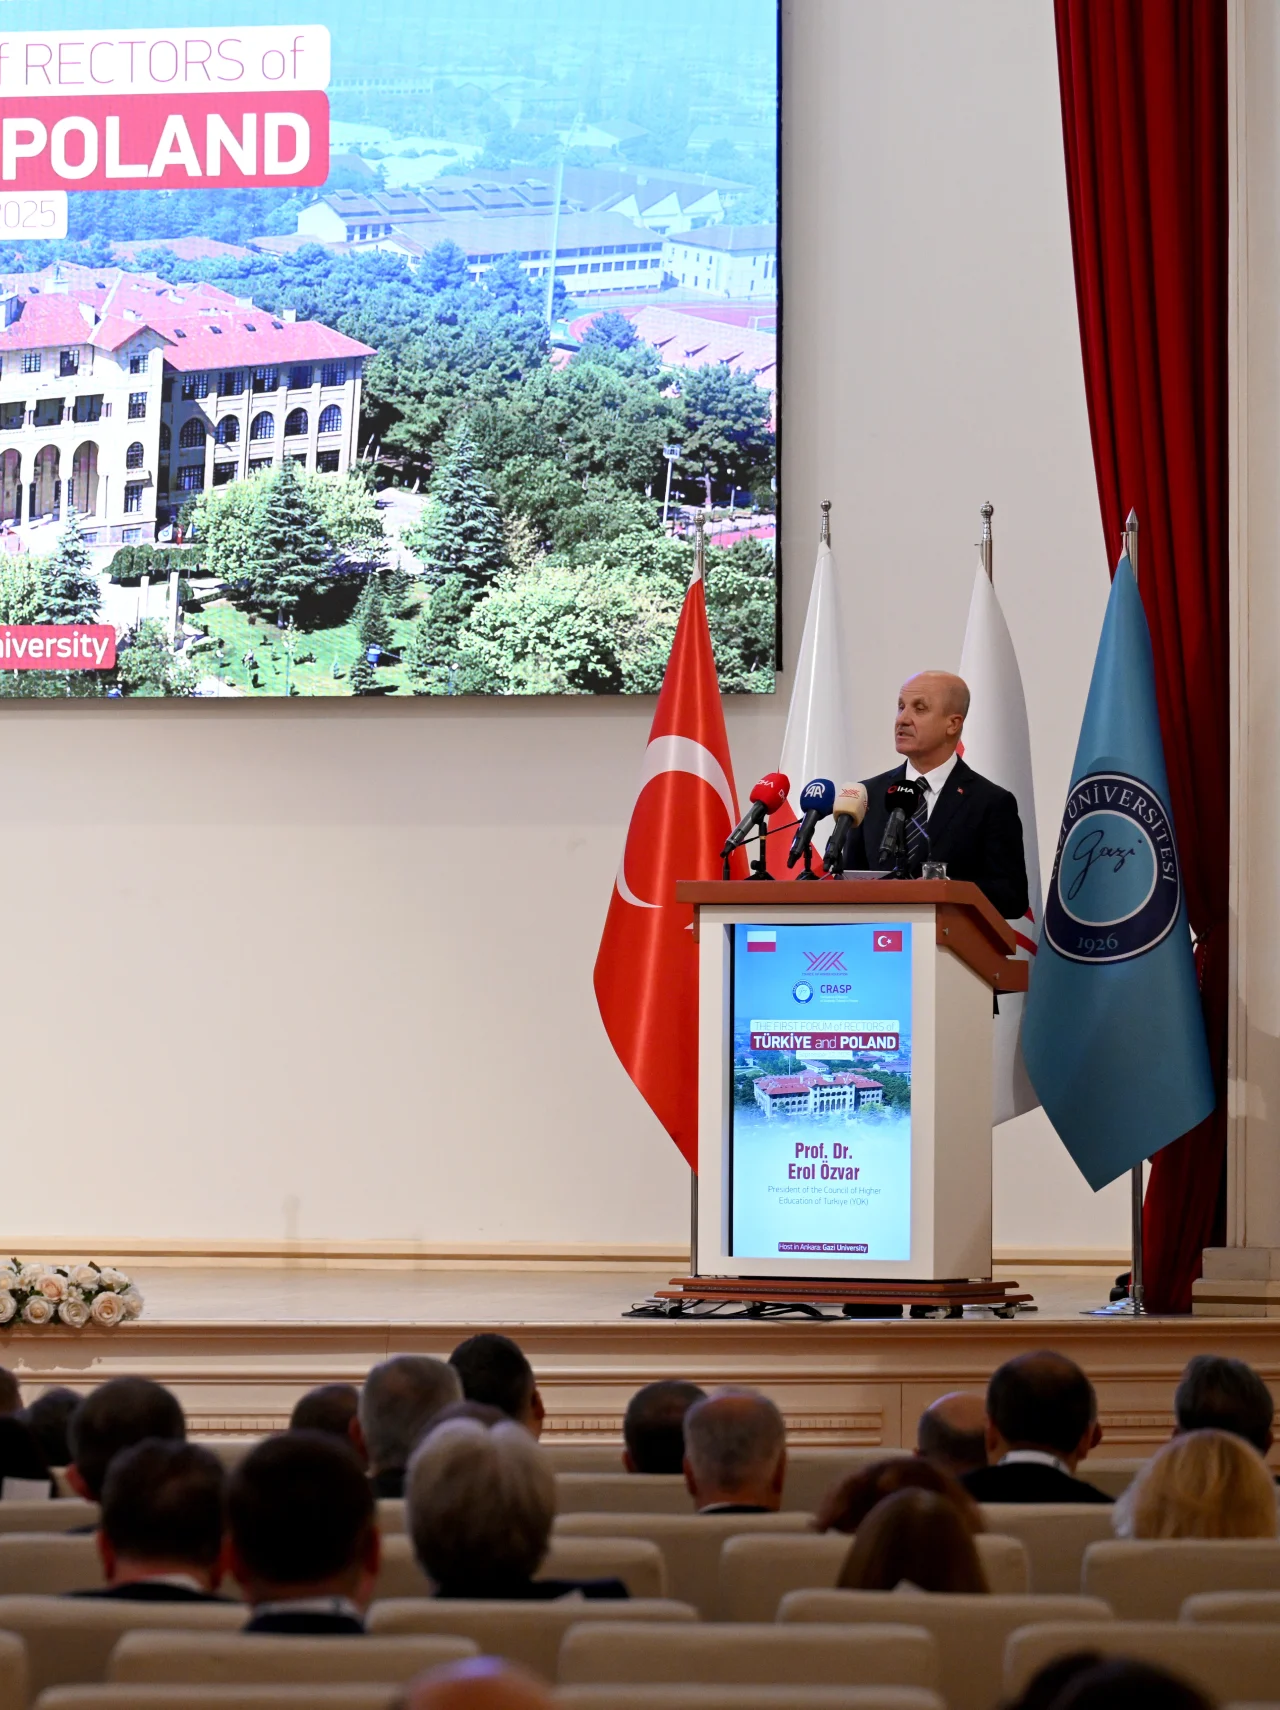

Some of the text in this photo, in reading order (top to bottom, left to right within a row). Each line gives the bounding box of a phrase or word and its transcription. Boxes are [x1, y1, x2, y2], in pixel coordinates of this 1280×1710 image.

[25, 38, 245, 86] RECTORS
[261, 35, 305, 81] of
[2, 112, 310, 181] POLAND
[1077, 931, 1119, 955] 1926
[820, 984, 852, 994] CRASP
[754, 1021, 895, 1031] THE FIRST FORUM of RECTORS of
[754, 1033, 896, 1049] TÜRKİYE and POLAND
[795, 1142, 853, 1159] Prof. Dr.
[788, 1160, 860, 1180] Erol Özvar
[768, 1185, 882, 1196] President of the Council of Higher
[778, 1196, 813, 1205] Education
[814, 1196, 822, 1205] of
[836, 1244, 868, 1253] University
